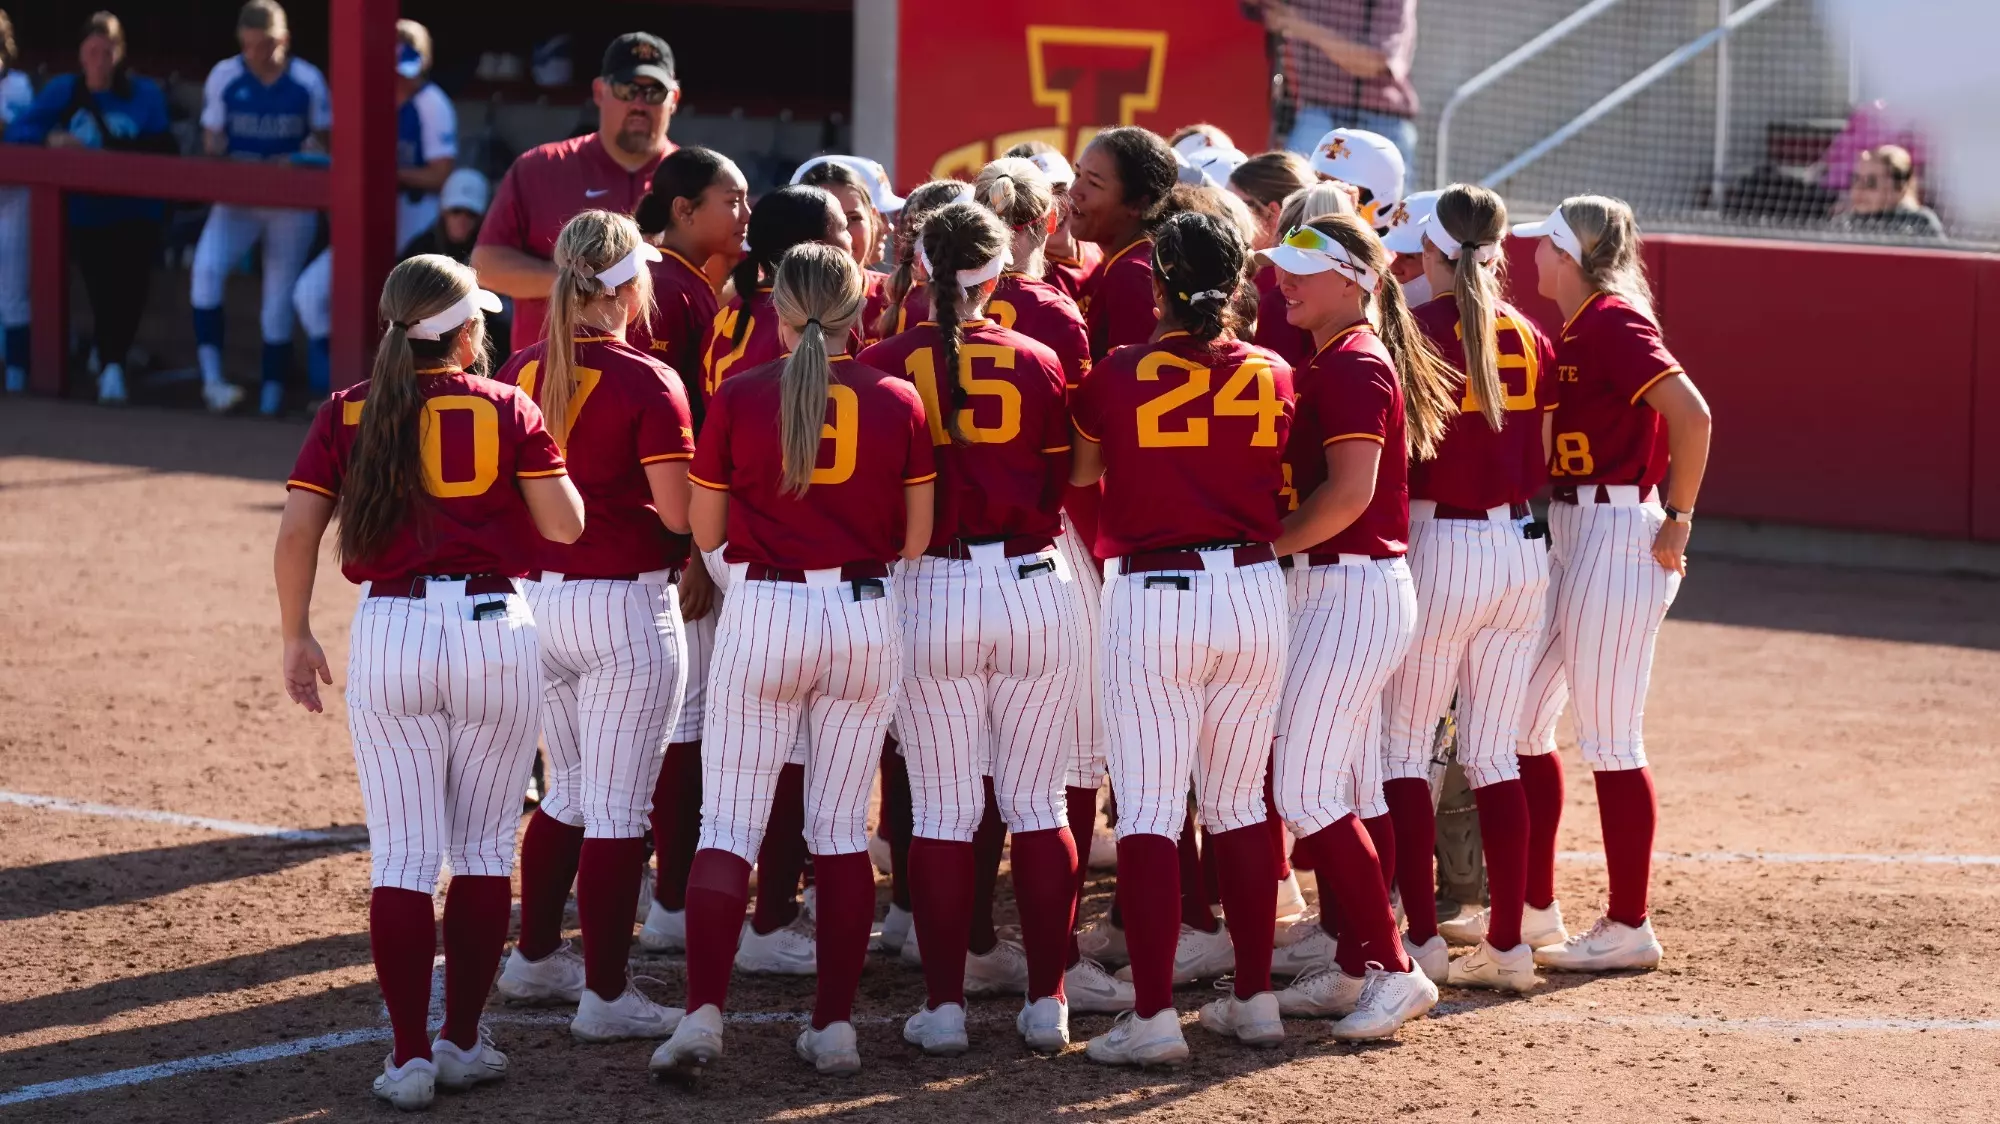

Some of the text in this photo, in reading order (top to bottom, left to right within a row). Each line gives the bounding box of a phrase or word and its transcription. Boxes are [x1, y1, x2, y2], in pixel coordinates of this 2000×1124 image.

[905, 344, 1021, 446] 15
[1136, 351, 1284, 447] 24
[1454, 317, 1538, 412] 9
[343, 395, 499, 498] 0
